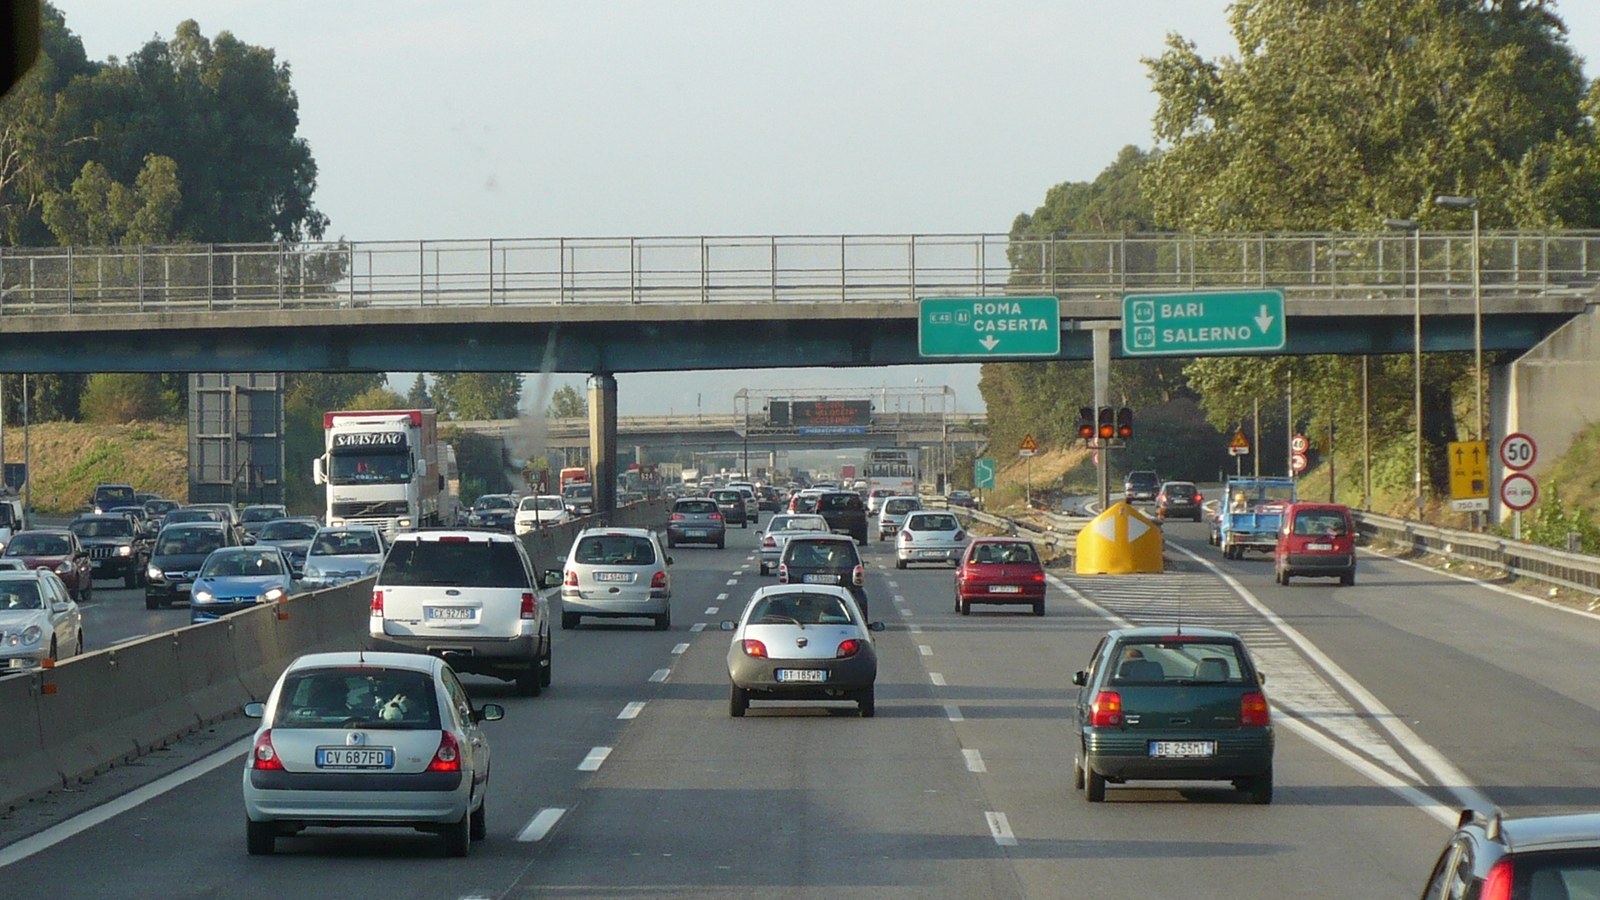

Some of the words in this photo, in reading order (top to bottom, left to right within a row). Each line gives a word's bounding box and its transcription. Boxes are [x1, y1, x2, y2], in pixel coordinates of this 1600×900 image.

[973, 302, 1021, 315] ROMA
[1161, 303, 1204, 318] BARI
[973, 318, 1048, 332] CASERTA
[1163, 326, 1251, 342] SALERNO
[336, 432, 401, 446] SAVASTANO
[1508, 443, 1530, 461] 50
[1457, 501, 1473, 509] 750
[783, 669, 793, 680] BT
[1157, 743, 1171, 754] BE
[1174, 743, 1205, 754] 253MT
[326, 751, 341, 764] CV
[345, 751, 384, 764] 687FD
